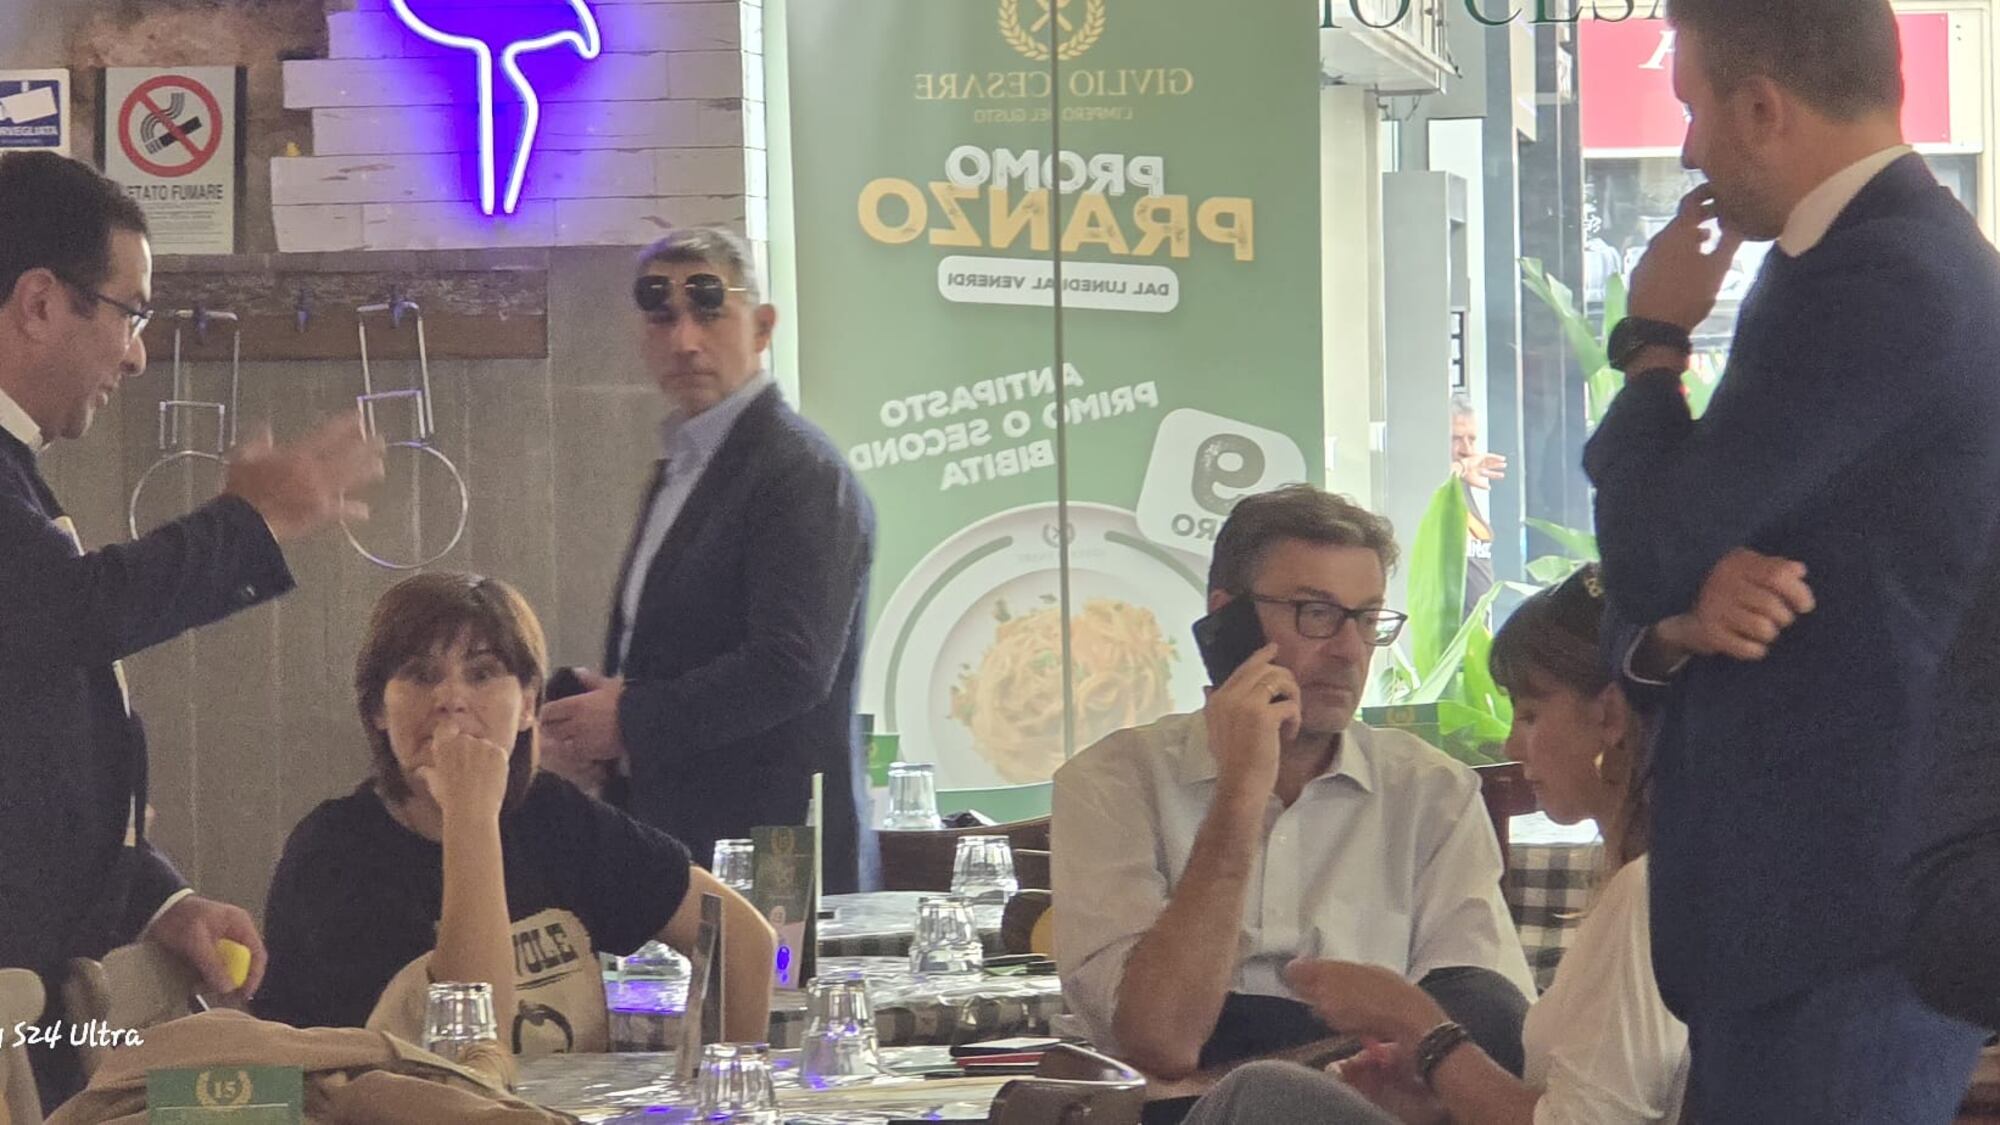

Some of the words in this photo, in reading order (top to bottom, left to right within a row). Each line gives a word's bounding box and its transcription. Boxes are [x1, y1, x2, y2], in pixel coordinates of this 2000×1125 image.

[127, 185, 167, 200] ETATO
[172, 184, 223, 200] FUMARE
[215, 1081, 236, 1099] 15
